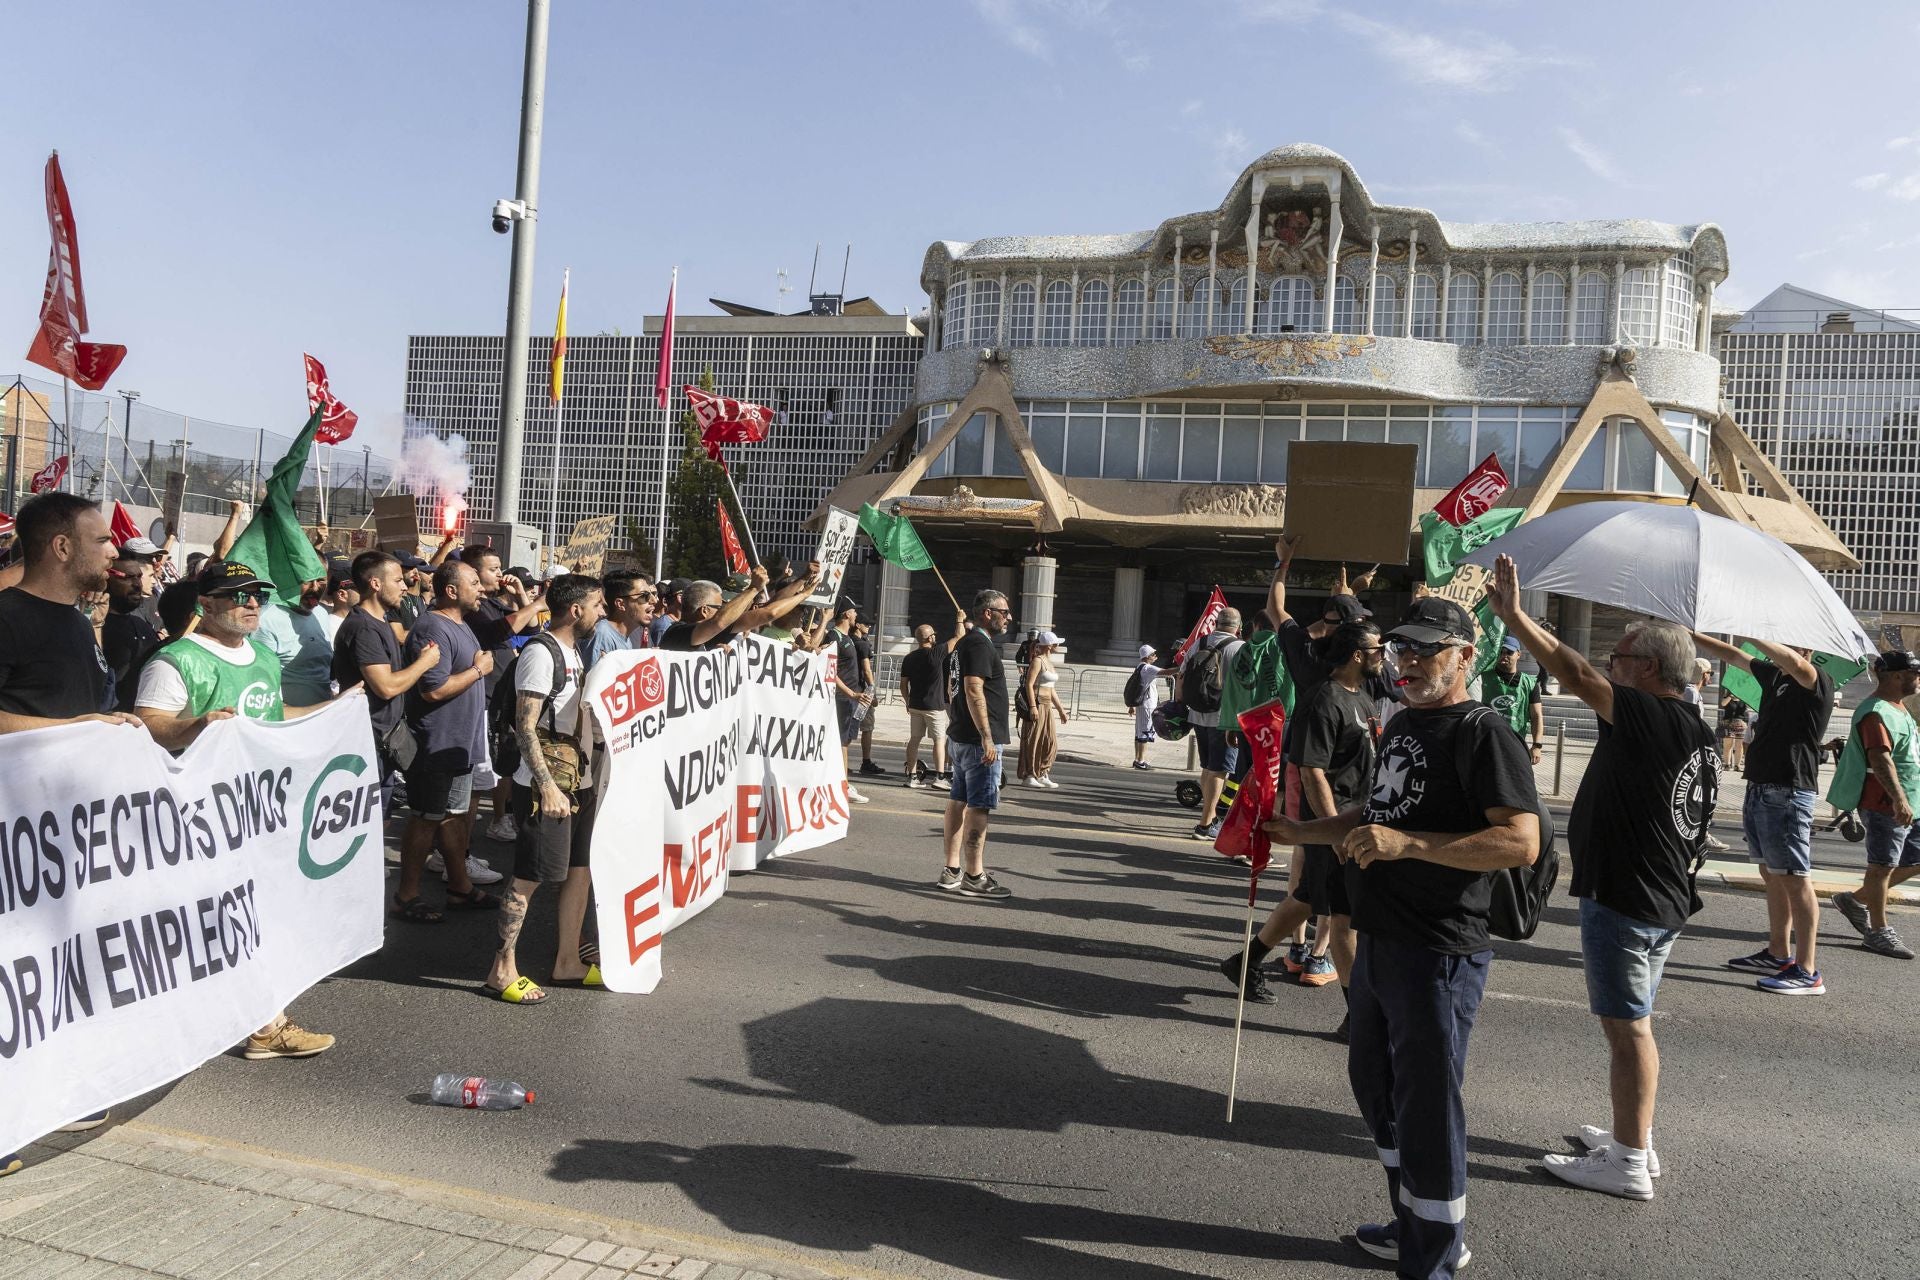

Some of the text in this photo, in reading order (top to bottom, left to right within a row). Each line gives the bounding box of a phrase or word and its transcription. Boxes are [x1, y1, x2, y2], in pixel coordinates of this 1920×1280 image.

[825, 529, 841, 548] SOY
[746, 637, 809, 696] PARA
[631, 710, 665, 748] FICA
[1382, 735, 1427, 769] THE CULT
[311, 782, 381, 840] CSIF
[737, 785, 777, 843] EN
[1367, 778, 1426, 823] TEMPLE
[0, 810, 66, 914] IOS
